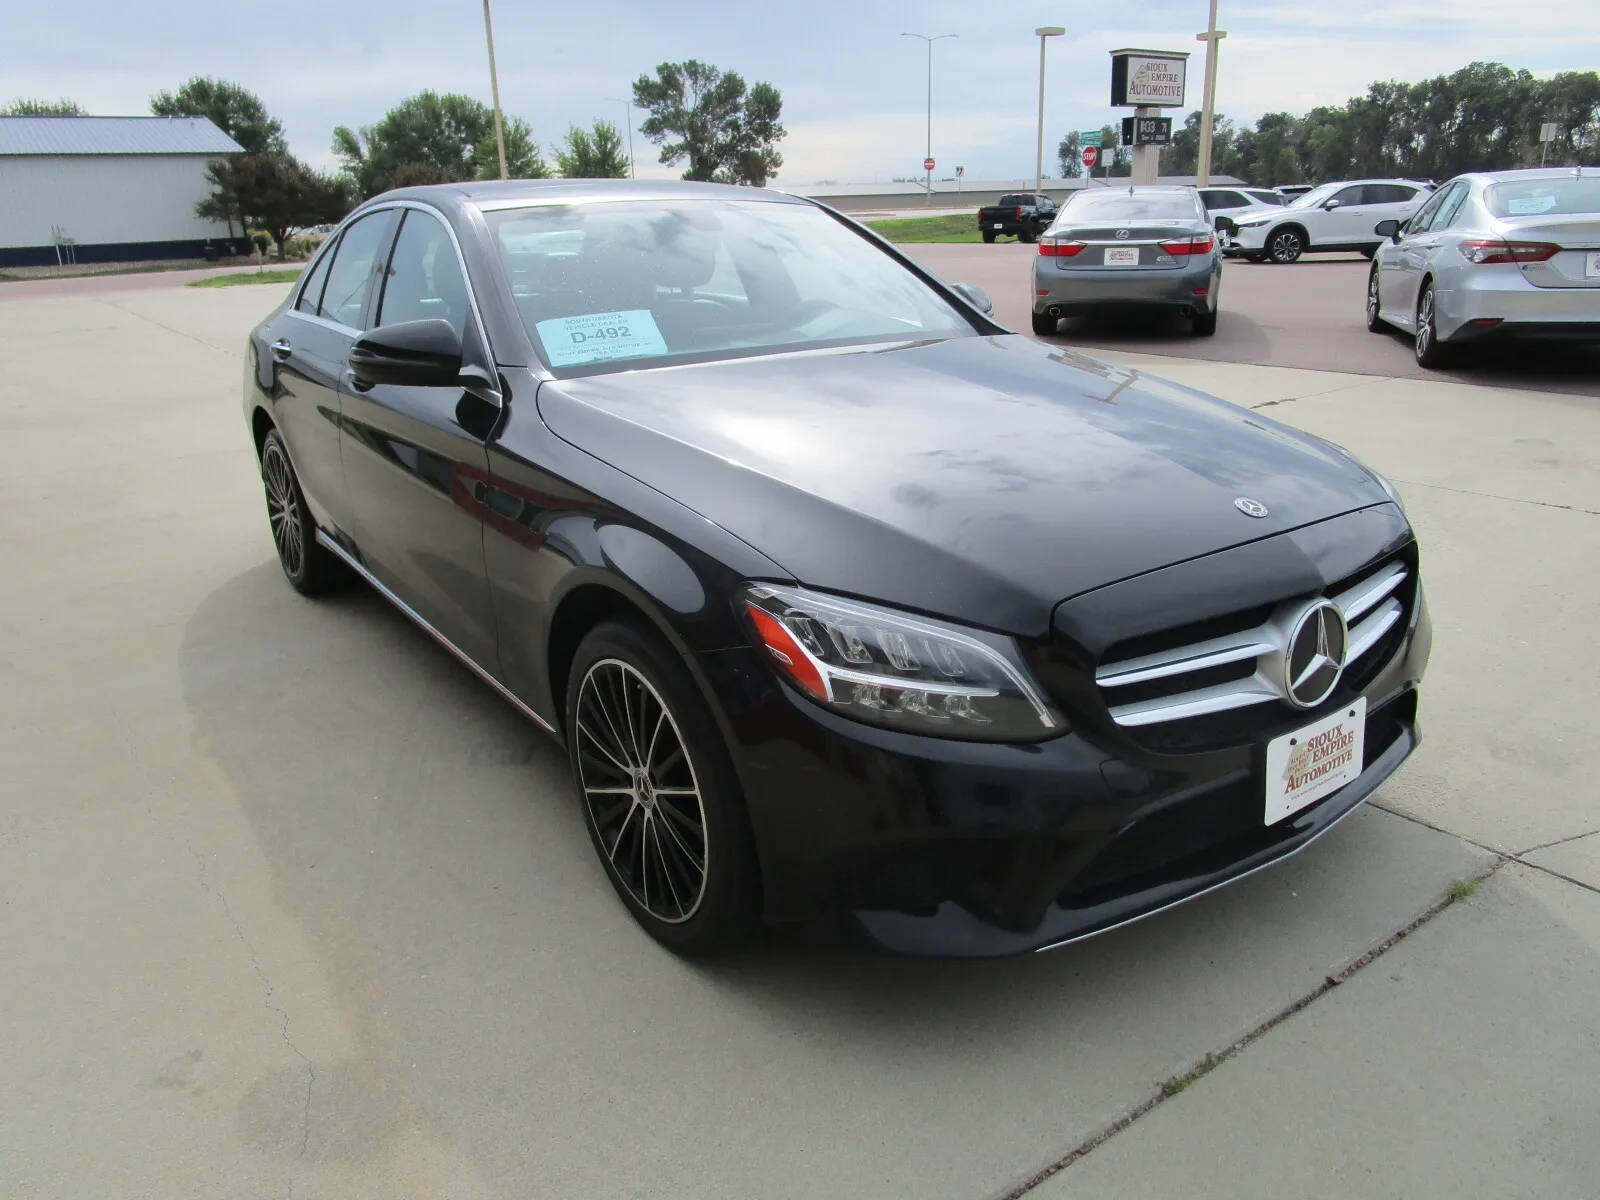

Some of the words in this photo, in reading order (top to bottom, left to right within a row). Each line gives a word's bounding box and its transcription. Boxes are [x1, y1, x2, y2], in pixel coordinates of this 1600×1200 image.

[1146, 63, 1168, 72] SIOUX
[1151, 73, 1178, 82] EMPIRE
[1129, 80, 1181, 96] AUTOMOTIVE
[1083, 152, 1096, 160] STOP
[564, 322, 596, 331] VEHICLE
[598, 319, 629, 327] DEALER
[565, 316, 591, 325] SOUTH
[591, 314, 623, 322] DAKOTA
[570, 326, 632, 343] D-492
[1307, 723, 1343, 752] SIOUX
[1312, 730, 1354, 764] EMPIRE
[1284, 749, 1353, 795] AUTOMOTIVE
